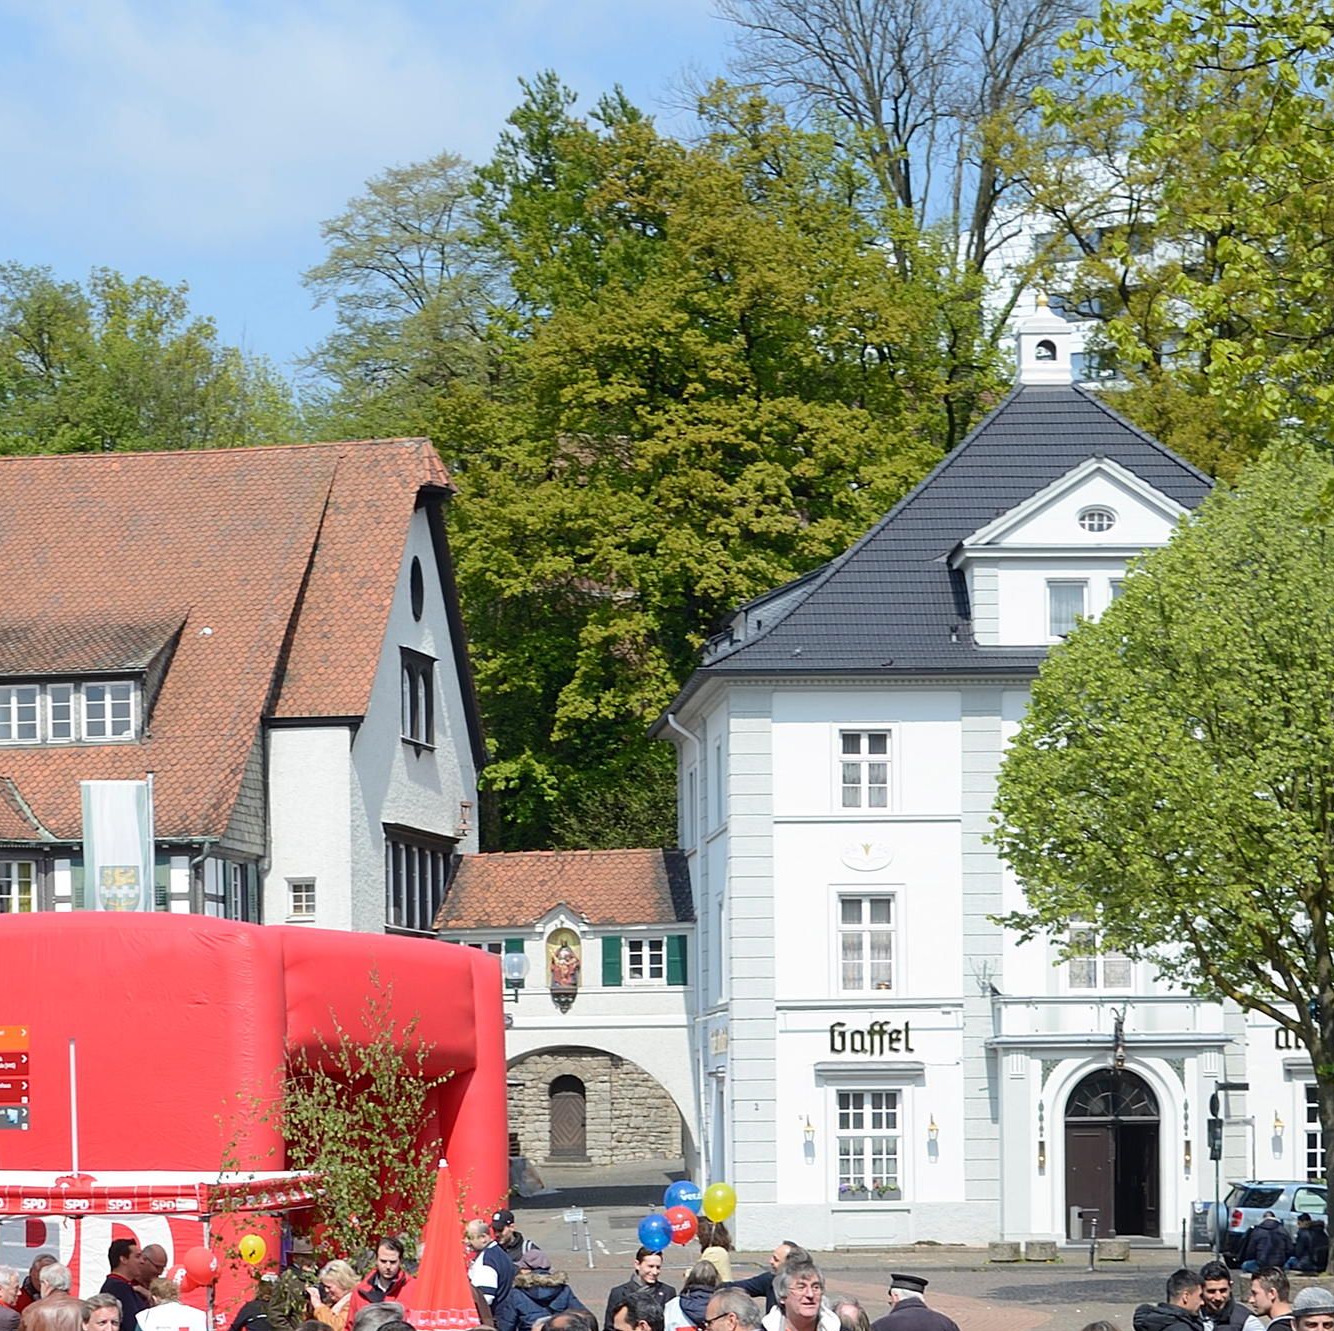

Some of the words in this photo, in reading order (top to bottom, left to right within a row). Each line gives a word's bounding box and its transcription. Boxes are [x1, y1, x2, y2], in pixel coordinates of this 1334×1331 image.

[829, 1020, 914, 1056] Gaffel
[23, 1199, 47, 1209] SPD
[64, 1199, 89, 1210] SPD
[107, 1200, 132, 1210] SPD
[151, 1200, 176, 1210] SPD
